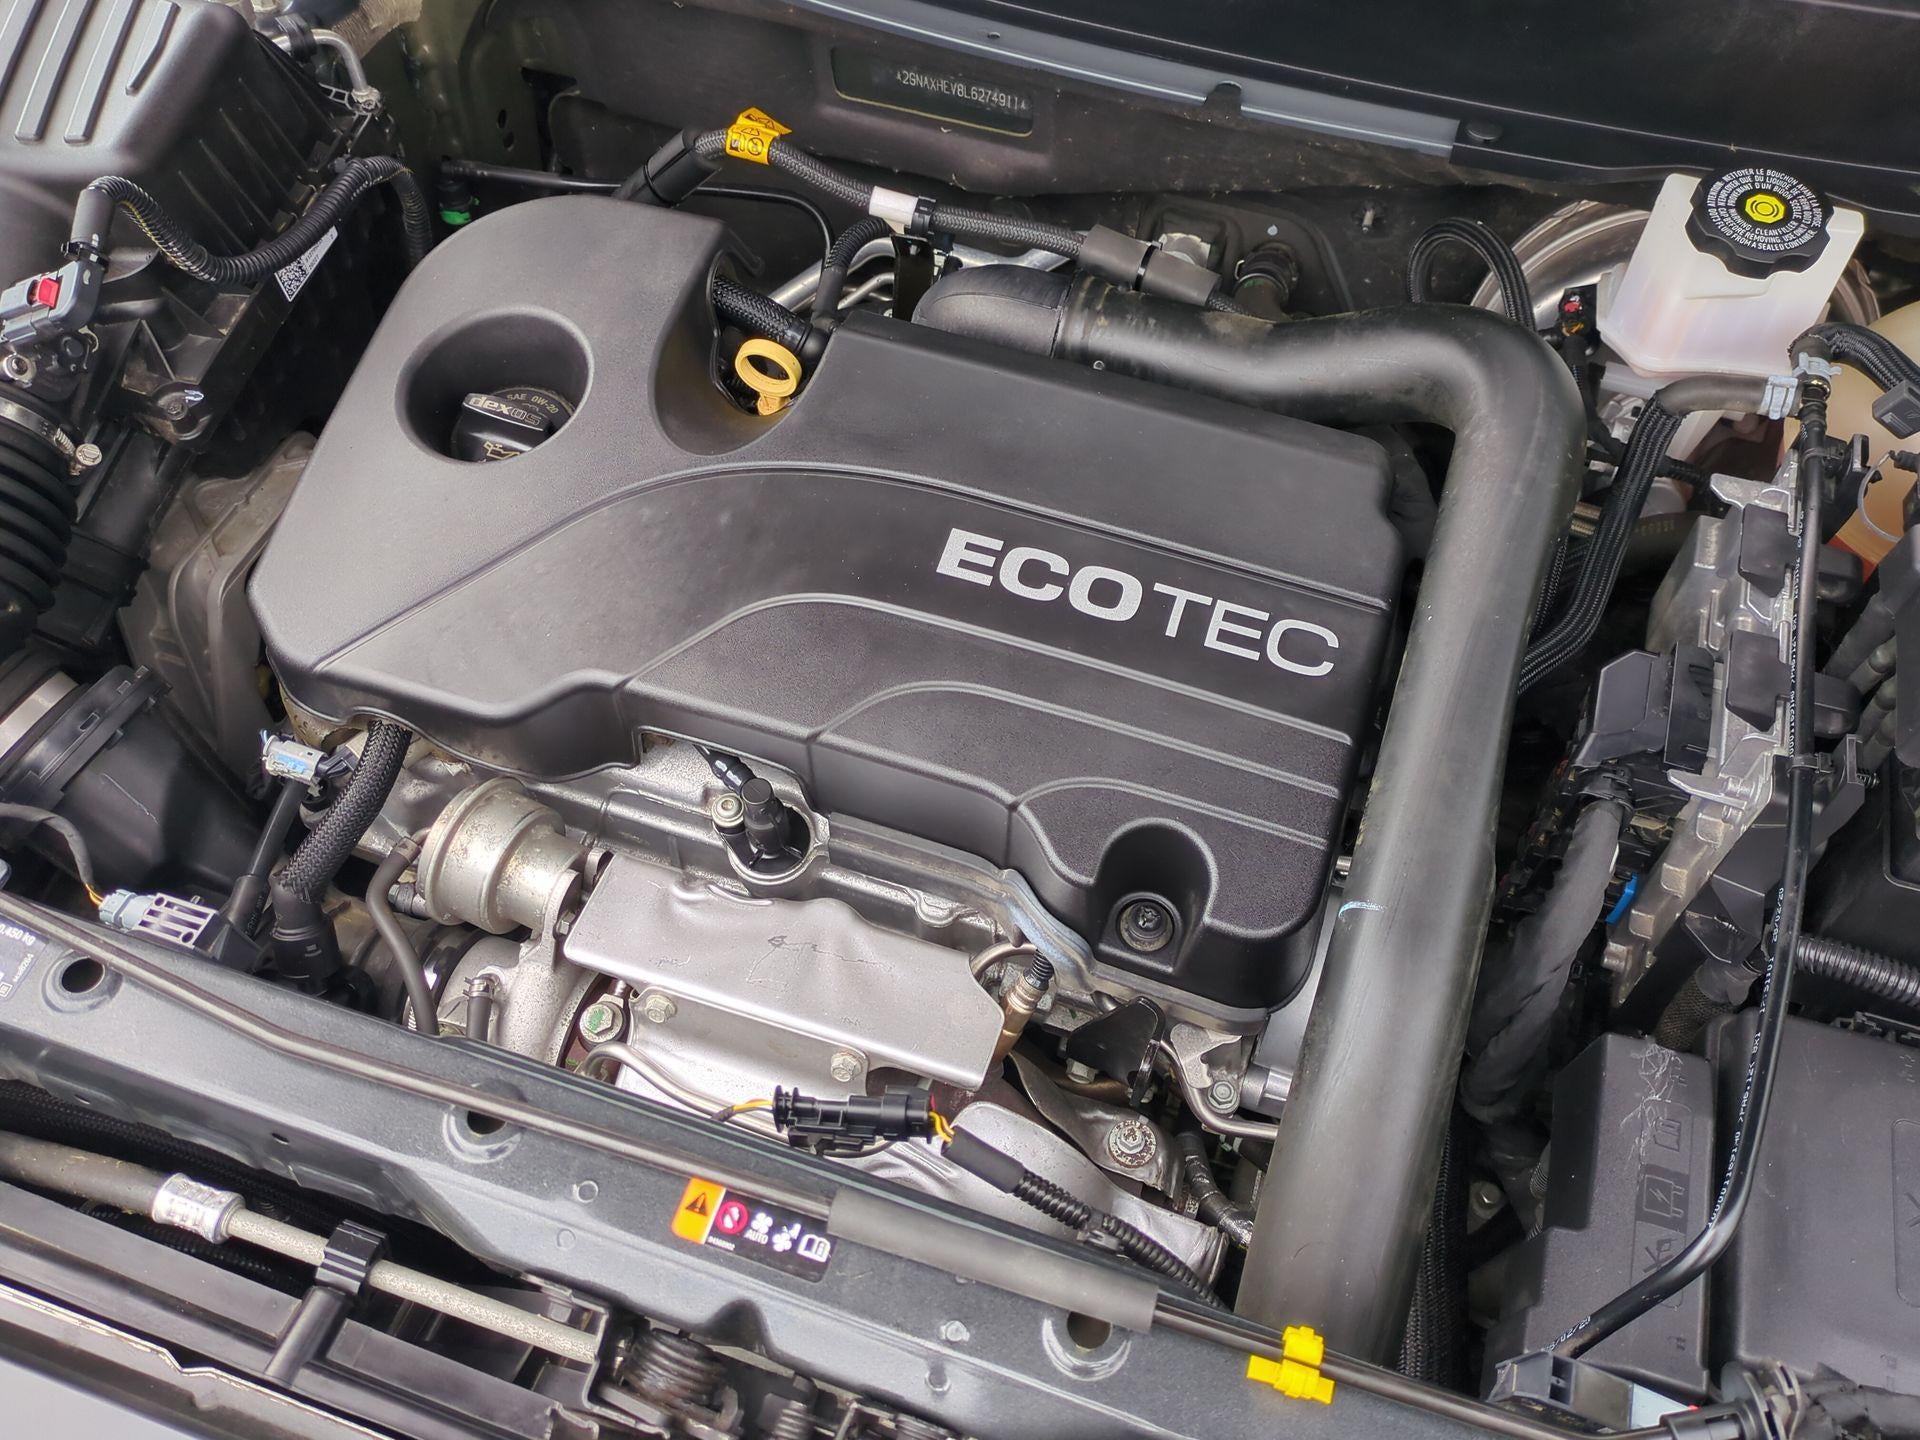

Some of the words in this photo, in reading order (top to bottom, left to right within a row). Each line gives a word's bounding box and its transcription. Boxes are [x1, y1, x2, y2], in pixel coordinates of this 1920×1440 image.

[1722, 168, 1754, 182] NETTOYER
[1755, 168, 1764, 176] LE
[1766, 169, 1799, 186] BOUCHON
[1796, 183, 1816, 200] AVANT
[1739, 175, 1753, 184] QUE
[1766, 176, 1792, 190] LIQUIDE
[1790, 187, 1801, 196] DE
[1773, 185, 1794, 200] BIDON
[1717, 207, 1729, 218] CAP
[1723, 217, 1746, 236] BEFORE
[1782, 232, 1797, 242] USE
[1793, 223, 1809, 237] ONLY
[1755, 227, 1779, 236] CLEAN
[1778, 221, 1799, 235] FILLER
[1715, 221, 1734, 236] FLUID
[1731, 233, 1752, 247] FROM
[1757, 242, 1785, 251] SEALED
[506, 393, 527, 401] SAE
[936, 527, 1340, 677] ECOTEC
[743, 1229, 769, 1245] AUTO
